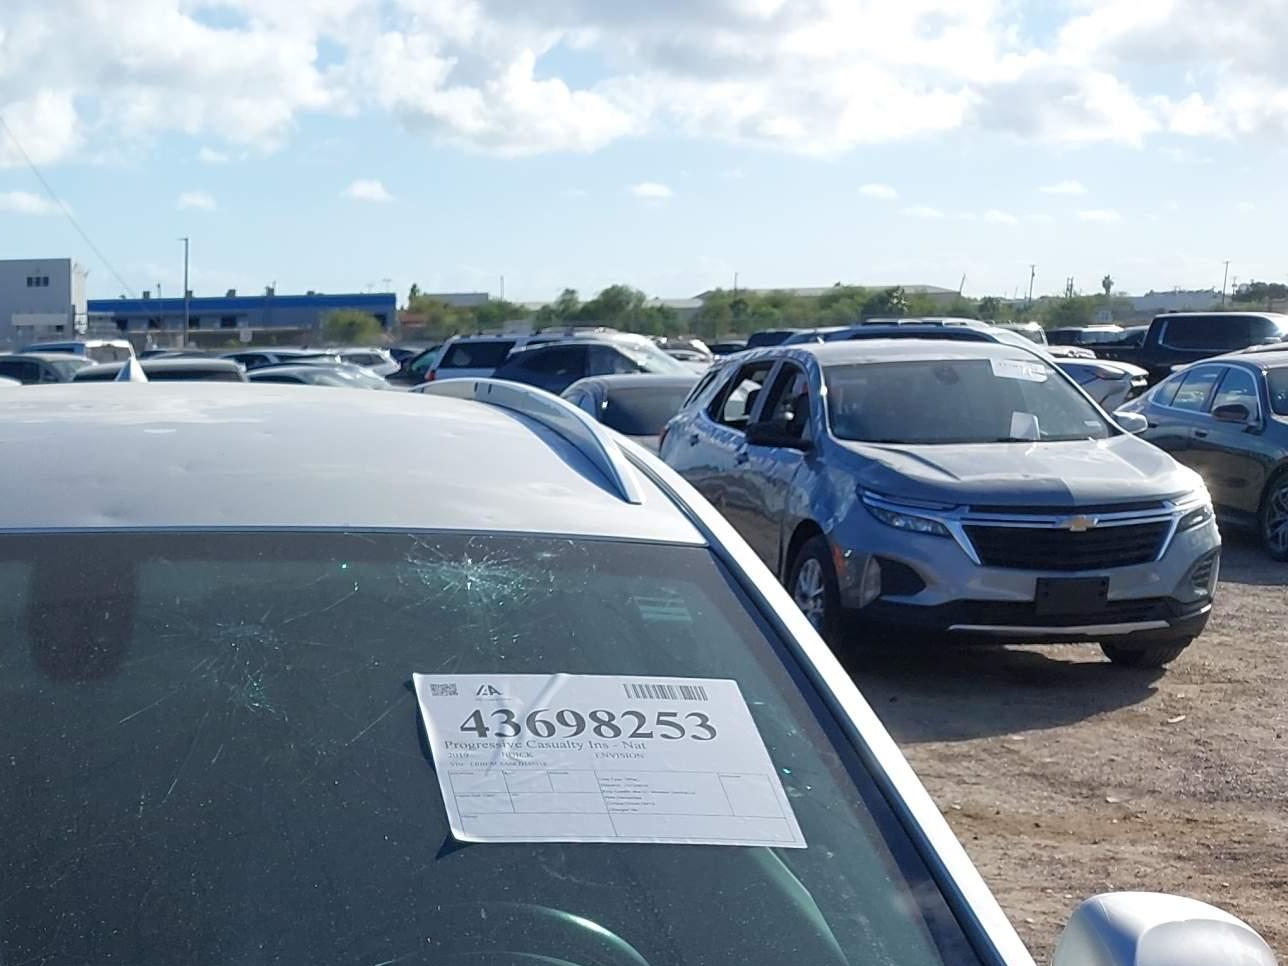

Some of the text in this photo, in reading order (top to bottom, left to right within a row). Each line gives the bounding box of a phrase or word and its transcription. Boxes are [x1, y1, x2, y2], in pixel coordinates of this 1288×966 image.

[460, 709, 717, 741] 43698253
[444, 740, 522, 750] Progressive
[526, 740, 583, 751] Casualty
[589, 741, 609, 749] Ins
[622, 740, 646, 750] Nat
[595, 752, 645, 760] ENVISION
